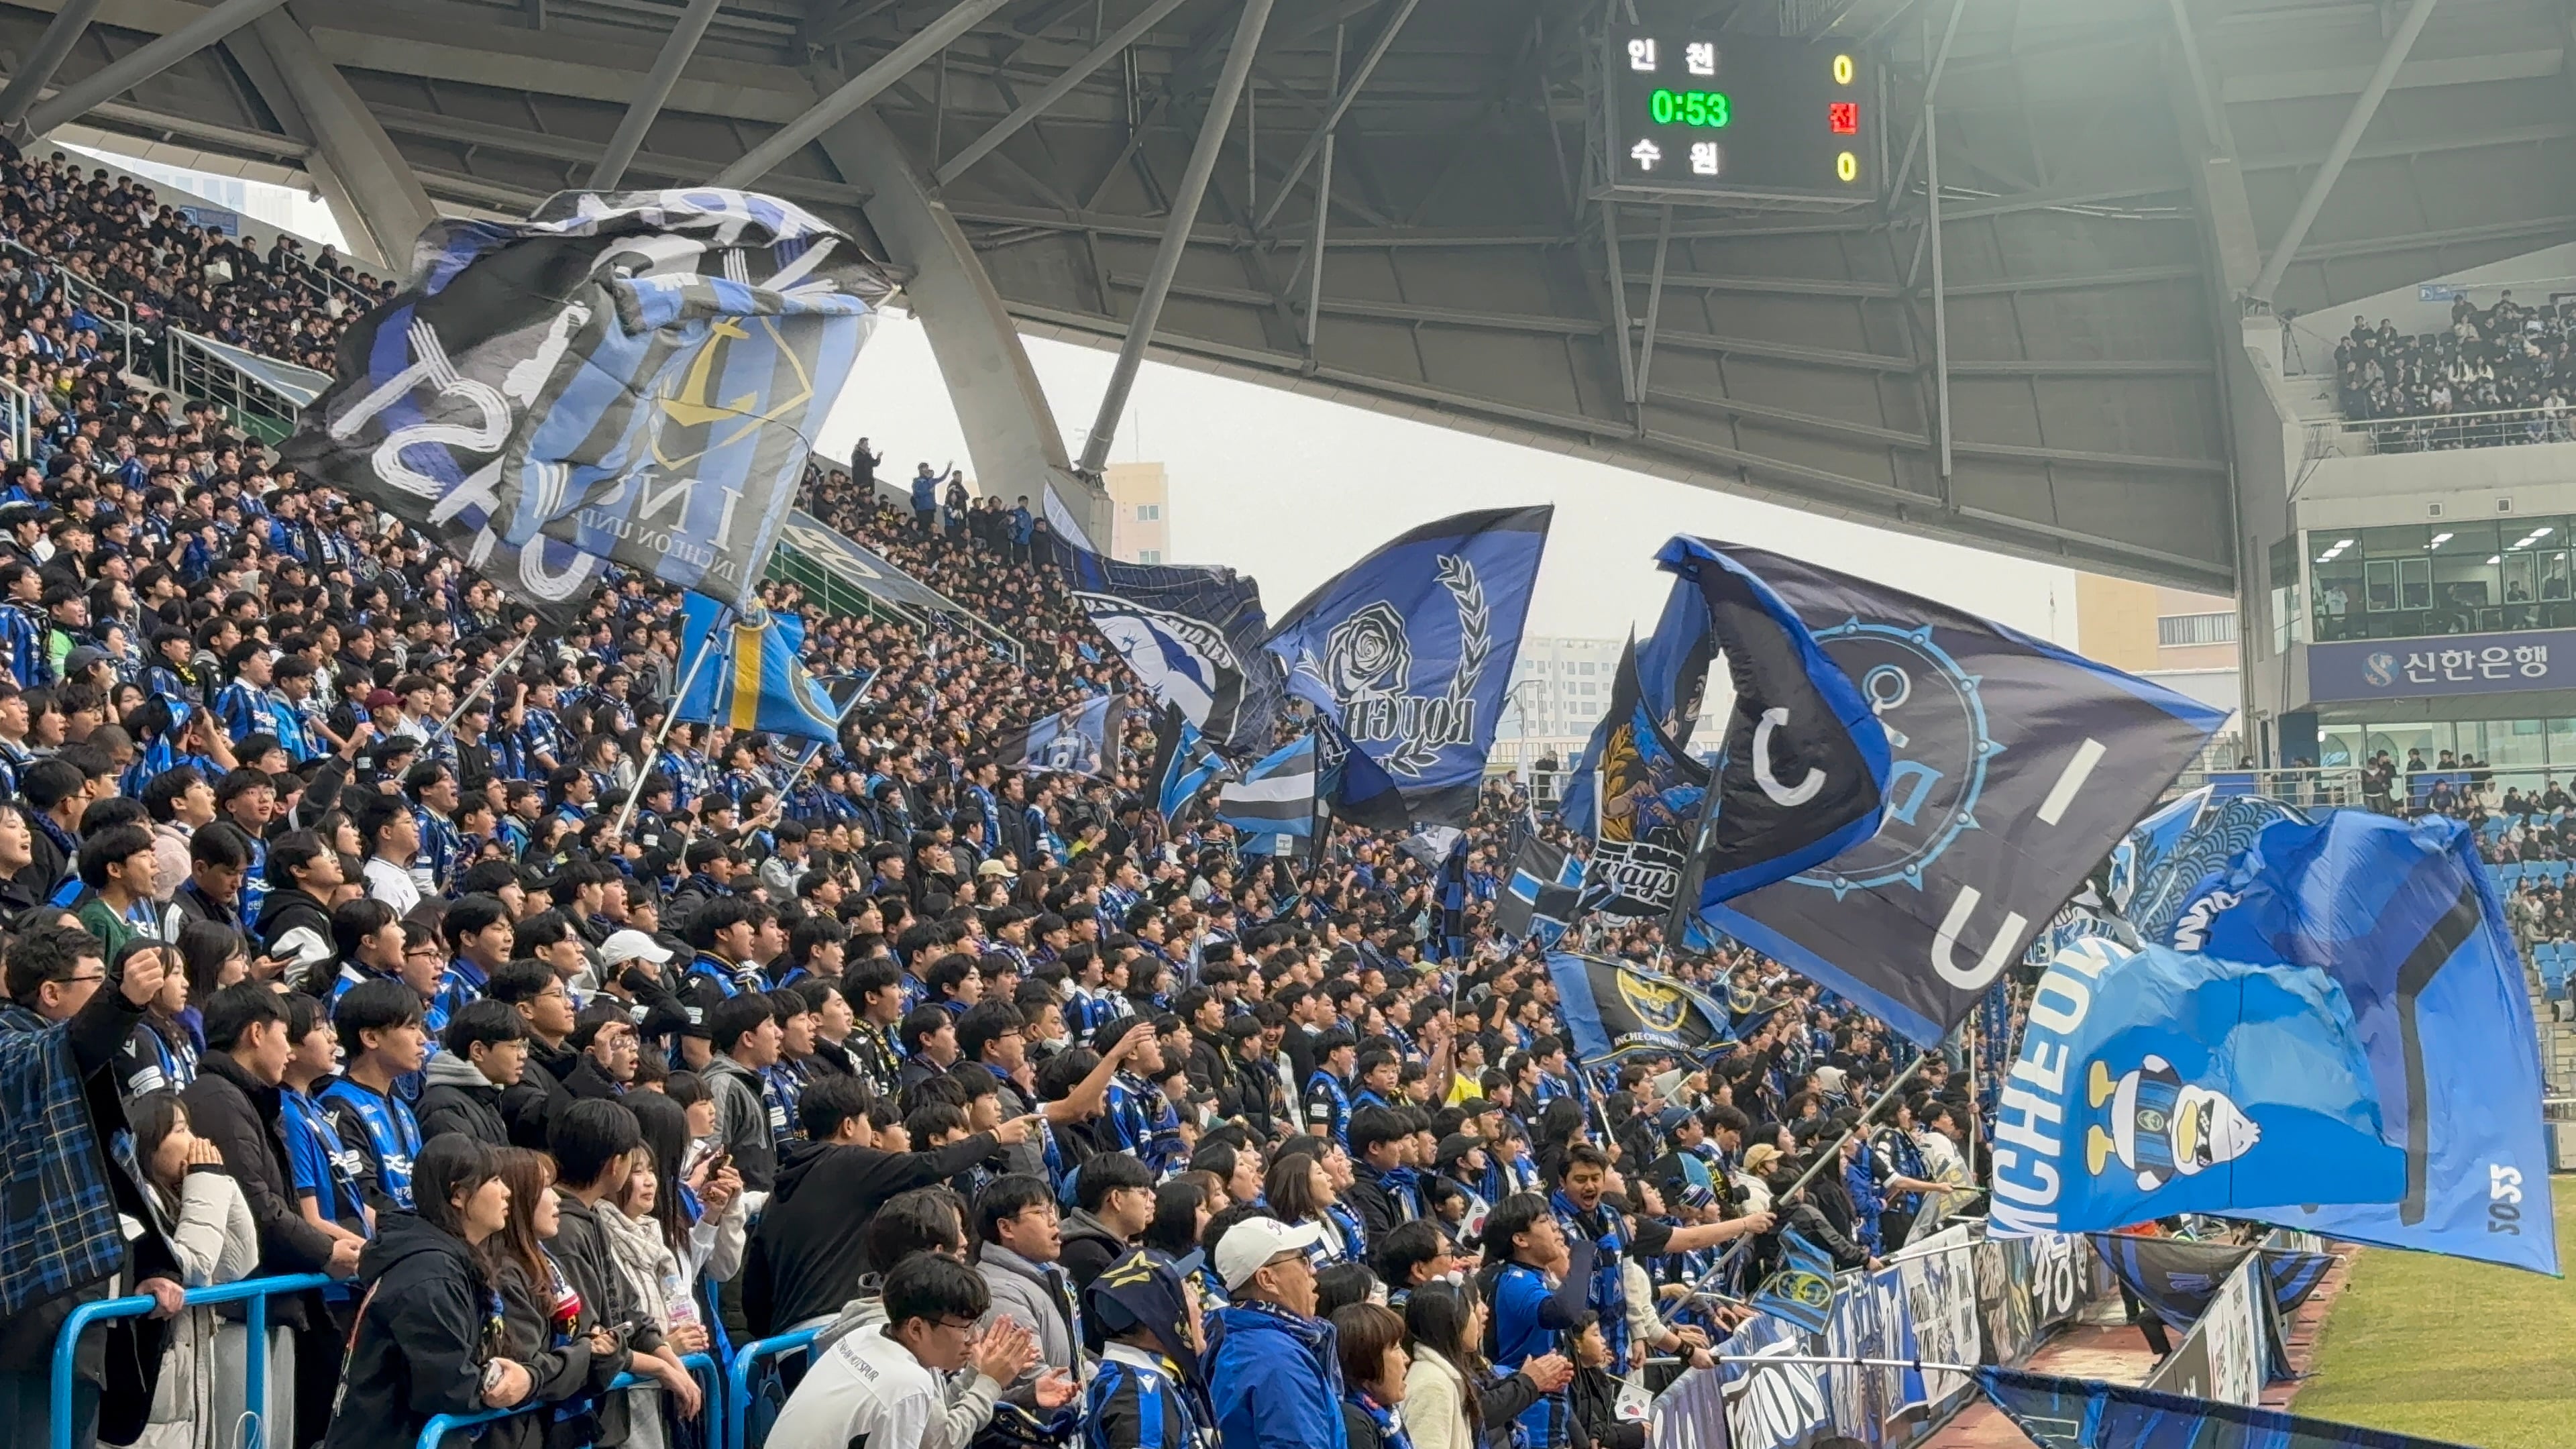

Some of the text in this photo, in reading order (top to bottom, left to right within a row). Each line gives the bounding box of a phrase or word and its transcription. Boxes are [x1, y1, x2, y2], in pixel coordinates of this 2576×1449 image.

[1833, 54, 1854, 85] 0
[1652, 89, 1729, 127] 0:53
[1837, 151, 1858, 182] 0
[2403, 645, 2548, 683] 신한은행
[1614, 1031, 1660, 1046] INCHEON
